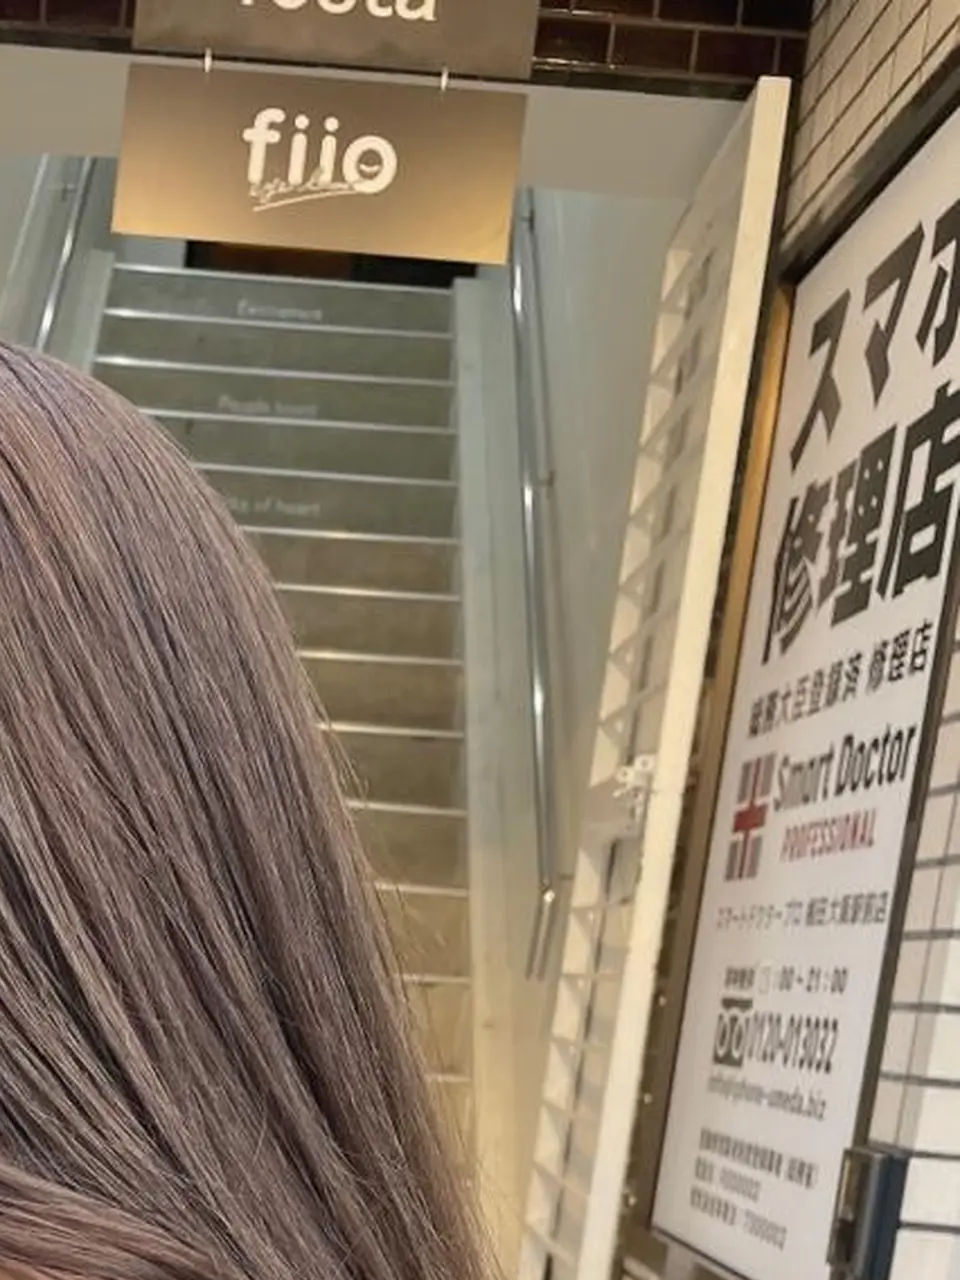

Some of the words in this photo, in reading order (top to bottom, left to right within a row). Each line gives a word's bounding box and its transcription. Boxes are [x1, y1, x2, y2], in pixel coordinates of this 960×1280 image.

[762, 380, 960, 665] 修理店
[773, 742, 835, 812] Smart
[835, 723, 917, 796] Doctor
[780, 809, 876, 862] PROFESSIONAL
